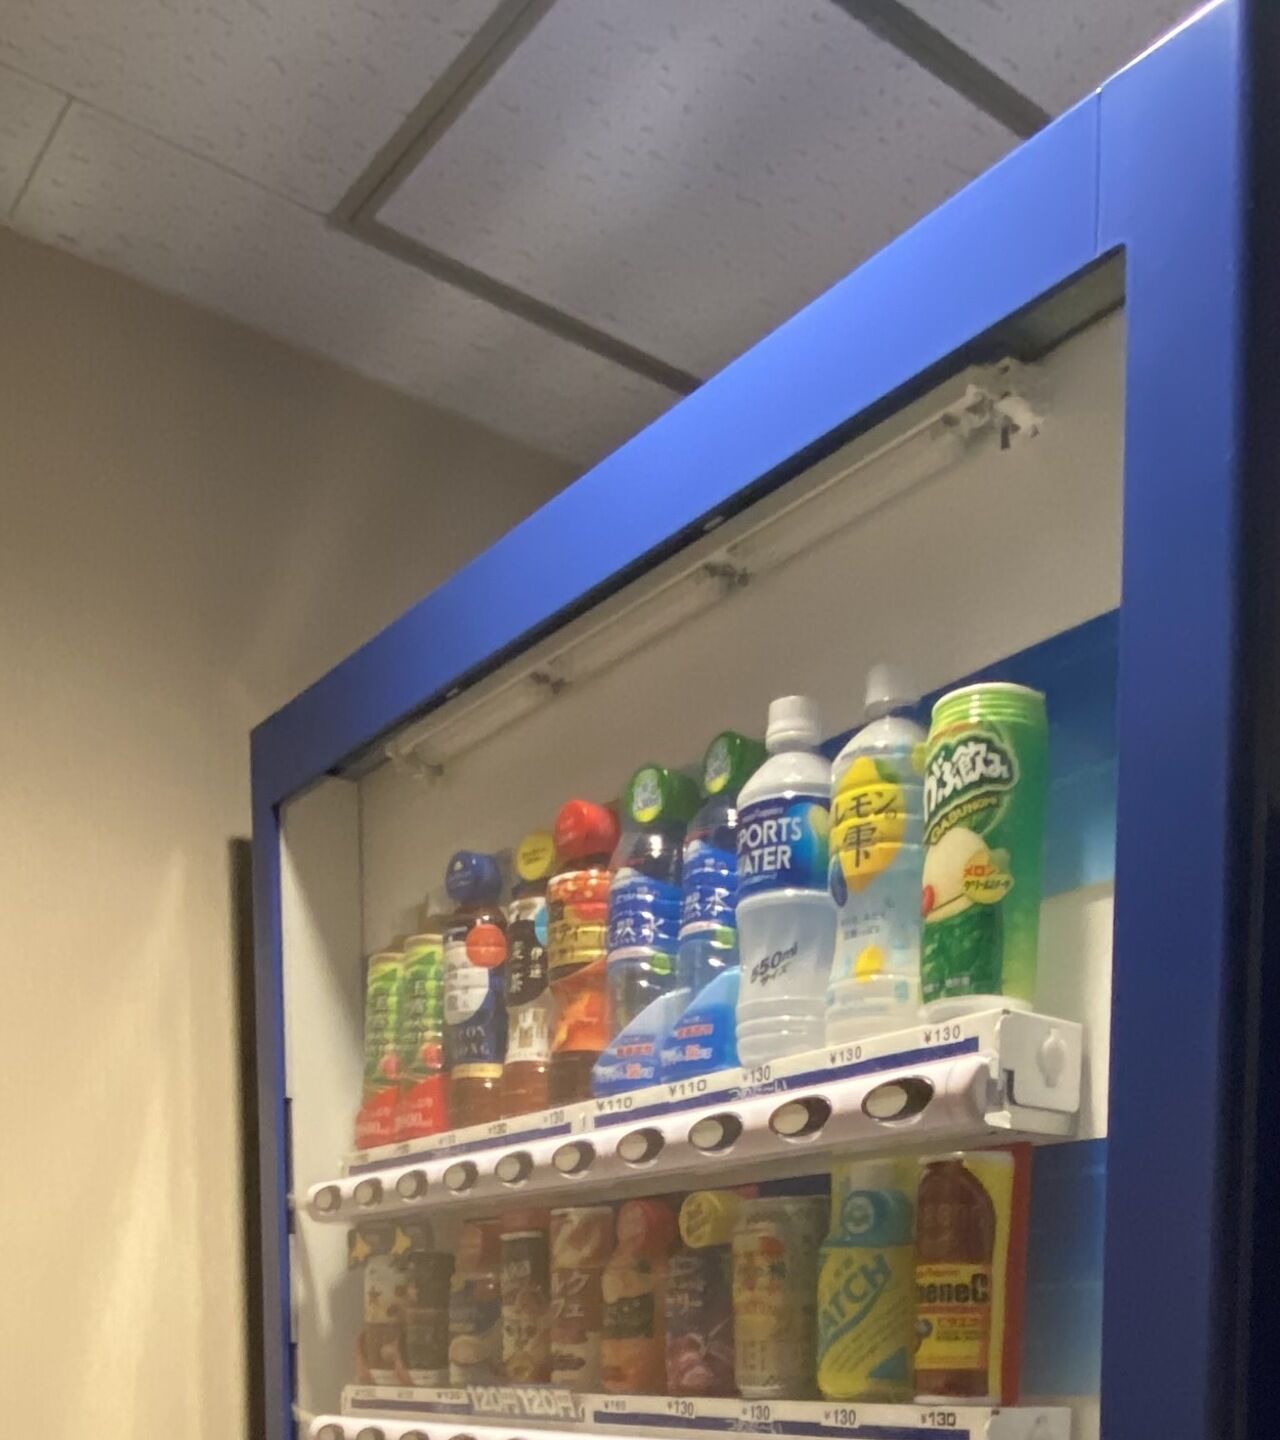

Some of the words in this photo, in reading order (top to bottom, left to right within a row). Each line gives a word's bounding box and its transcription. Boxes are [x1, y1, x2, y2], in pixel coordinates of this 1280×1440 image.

[668, 1078, 708, 1098] ¥110
[830, 1045, 863, 1066] ¥130
[923, 1025, 962, 1045] ¥130
[823, 1409, 858, 1427] ¥130
[920, 1413, 957, 1428] ¥130
